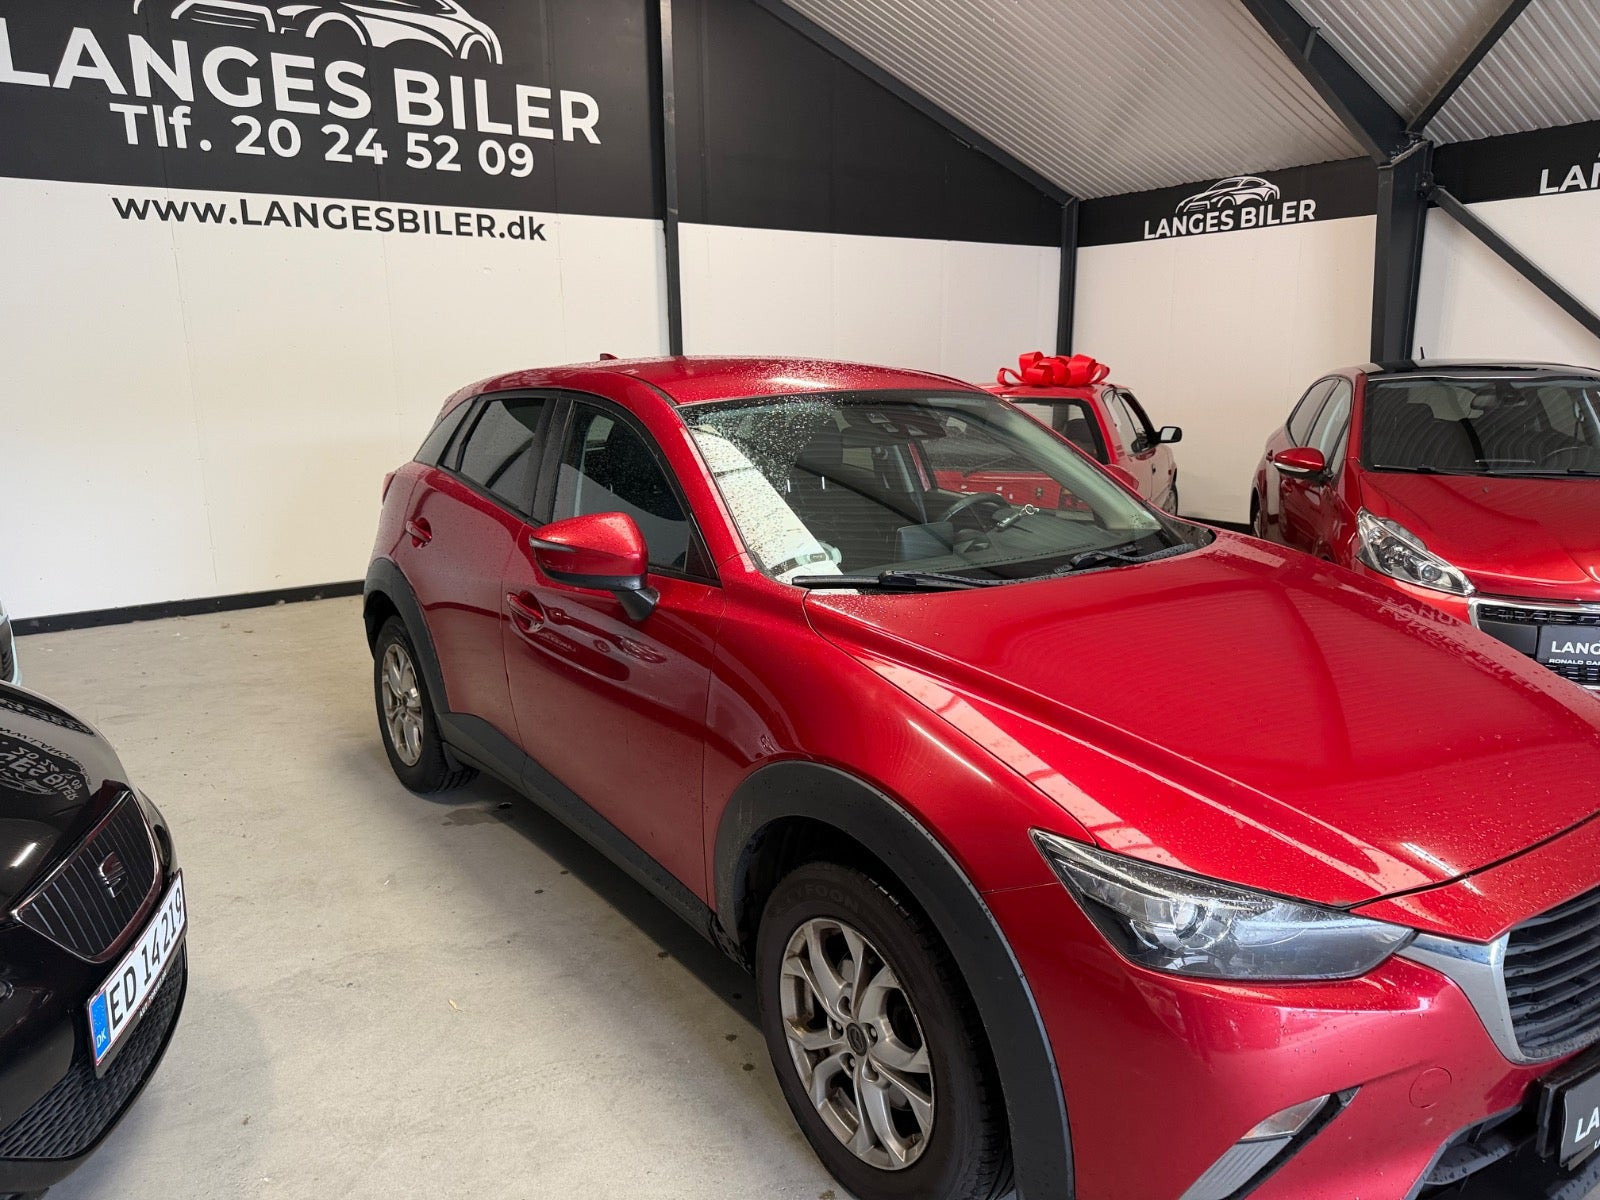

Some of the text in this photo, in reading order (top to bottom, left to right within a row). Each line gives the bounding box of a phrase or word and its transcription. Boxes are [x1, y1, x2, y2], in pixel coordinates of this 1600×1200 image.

[0, 17, 602, 145] LANGES BILER
[109, 102, 534, 178] Tlf. 20 24 52 09
[112, 197, 548, 242] www.LANGESBILER.dk
[1143, 199, 1317, 240] LANGES BILER
[1548, 658, 1584, 666] RONALD
[109, 965, 137, 1030] ED
[142, 927, 161, 986] 14
[161, 888, 183, 949] 219
[97, 1027, 107, 1049] DK
